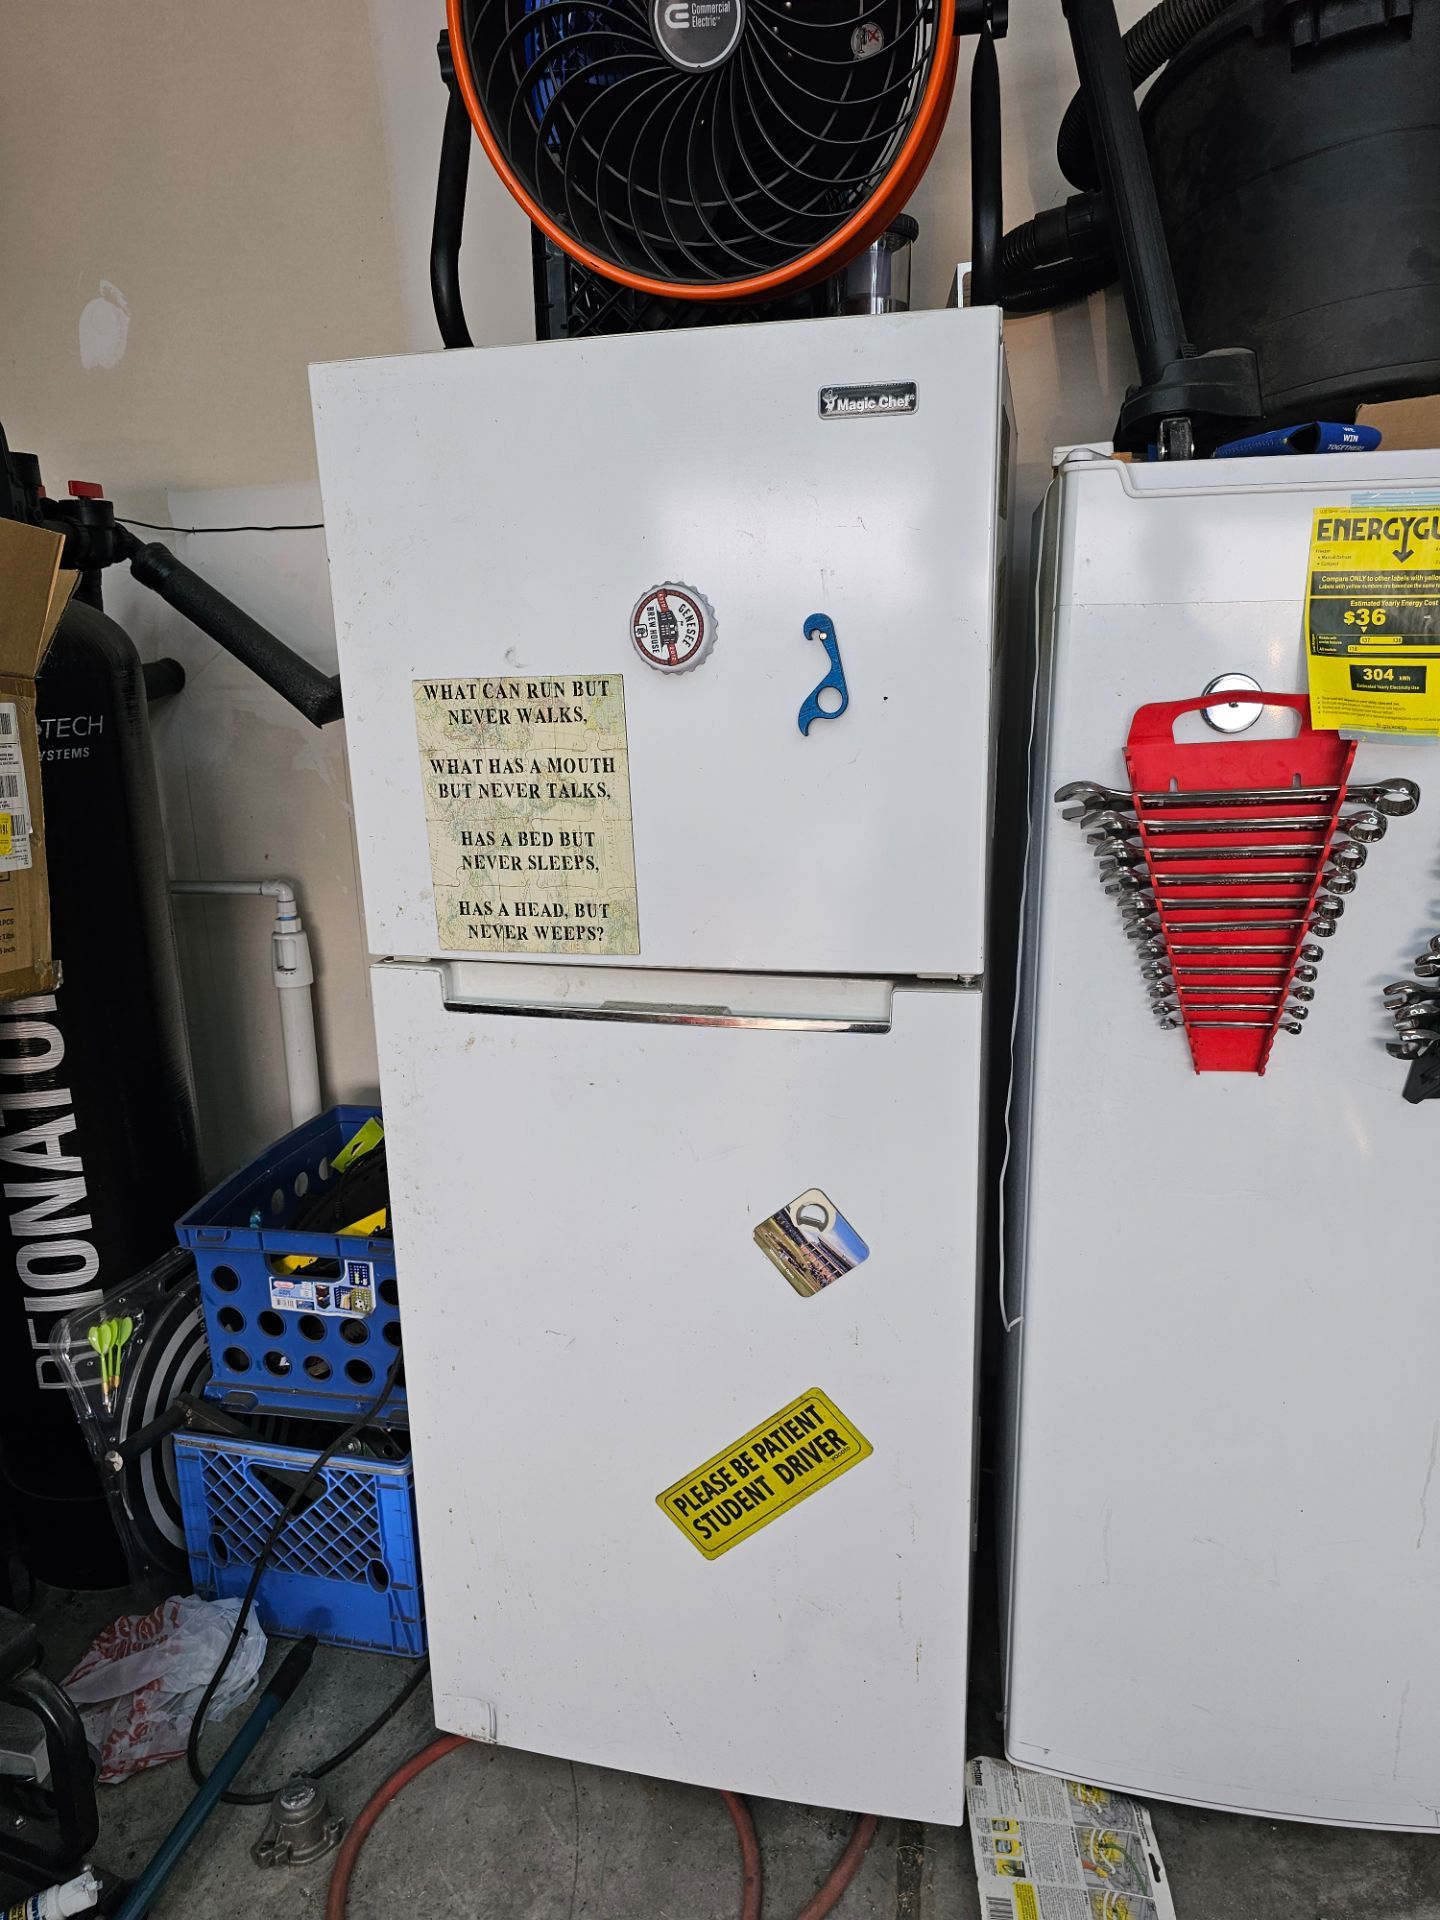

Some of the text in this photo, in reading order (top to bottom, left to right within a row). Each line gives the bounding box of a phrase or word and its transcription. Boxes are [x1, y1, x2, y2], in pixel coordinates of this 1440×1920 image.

[691, 1, 731, 15] Commercial
[837, 393, 910, 412] Magic Chef
[1343, 434, 1359, 442] WIN
[1350, 600, 1380, 608] Estimated
[1381, 600, 1400, 608] Yearly
[1401, 600, 1423, 608] Energy
[678, 603, 696, 648] GENESEE
[1343, 608, 1386, 627] $36
[647, 606, 660, 654] BREW HOUSE
[1362, 668, 1394, 681] 304
[424, 680, 610, 700] WHAT CAN RUN BUT
[448, 706, 588, 726] NEVER WALKS,
[430, 757, 615, 775] WHAT HAS A MOUTH
[438, 782, 611, 799] BUT NEVER TALKS,
[461, 831, 595, 847] HAS A BED BUT
[462, 855, 599, 872] NEVER SLEEPS,
[458, 900, 609, 919] HAS A HEAD, BUT
[468, 924, 604, 942] NEVER WEEPS?
[0, 993, 104, 1390] REIONATO
[671, 1403, 825, 1518] PLEASE BE PATIENT
[692, 1427, 848, 1540] STUDENT DRIVER
[972, 1759, 983, 1787] Prestone
